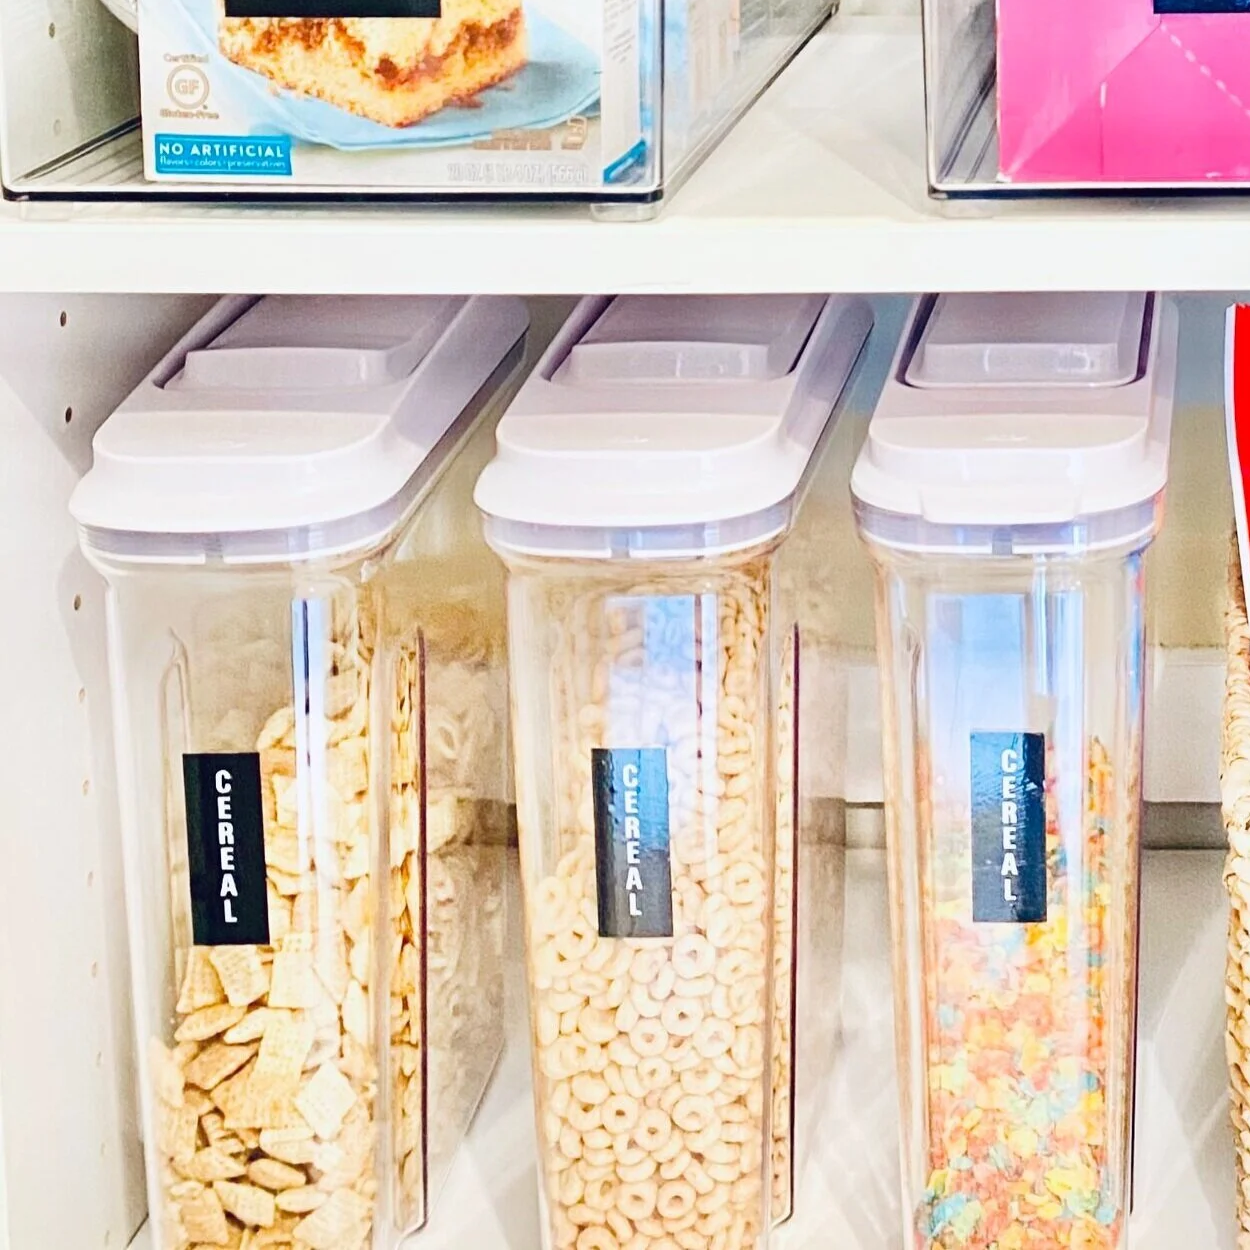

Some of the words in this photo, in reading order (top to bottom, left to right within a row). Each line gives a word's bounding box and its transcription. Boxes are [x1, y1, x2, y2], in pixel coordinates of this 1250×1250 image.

[159, 143, 184, 155] NO
[191, 144, 284, 158] ARTIFICIAL
[215, 769, 238, 923] CEREAL
[622, 764, 643, 917] CEREAL
[1000, 749, 1018, 901] CEREAL
